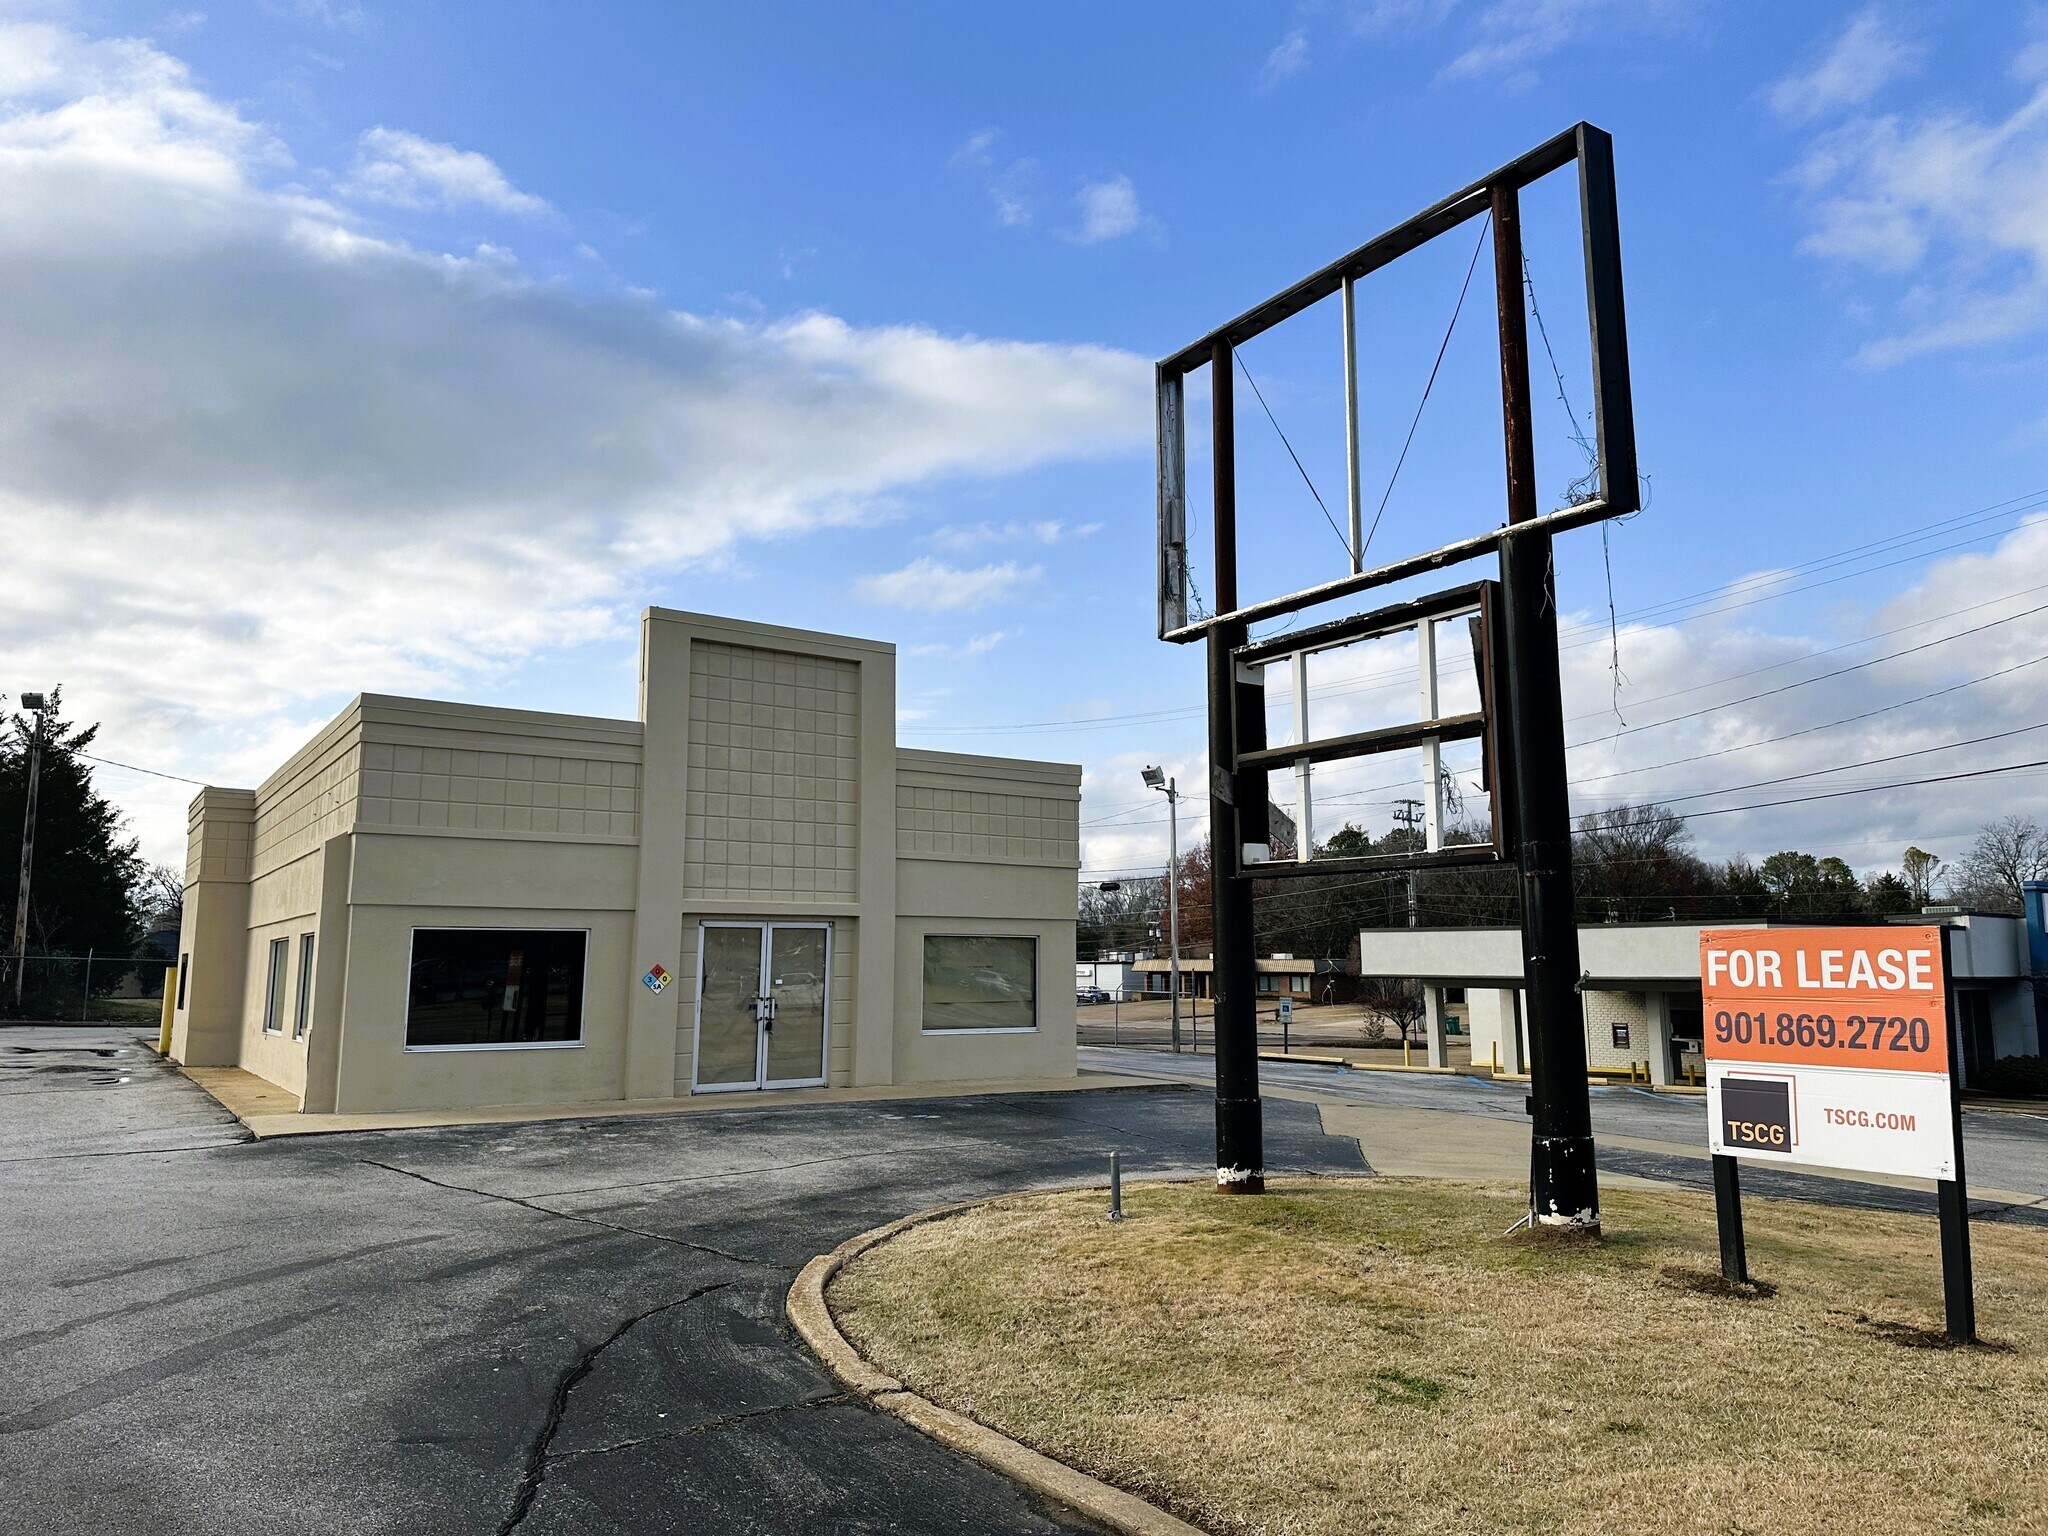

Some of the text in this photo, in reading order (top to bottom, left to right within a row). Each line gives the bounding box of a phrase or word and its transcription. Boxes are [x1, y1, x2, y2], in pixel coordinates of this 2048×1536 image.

[1707, 949, 1934, 990] FOR LEASE
[1714, 1010, 1930, 1053] 901.869.2720
[1727, 1120, 1785, 1145] TSCG
[1823, 1108, 1916, 1132] TSCG.COM
